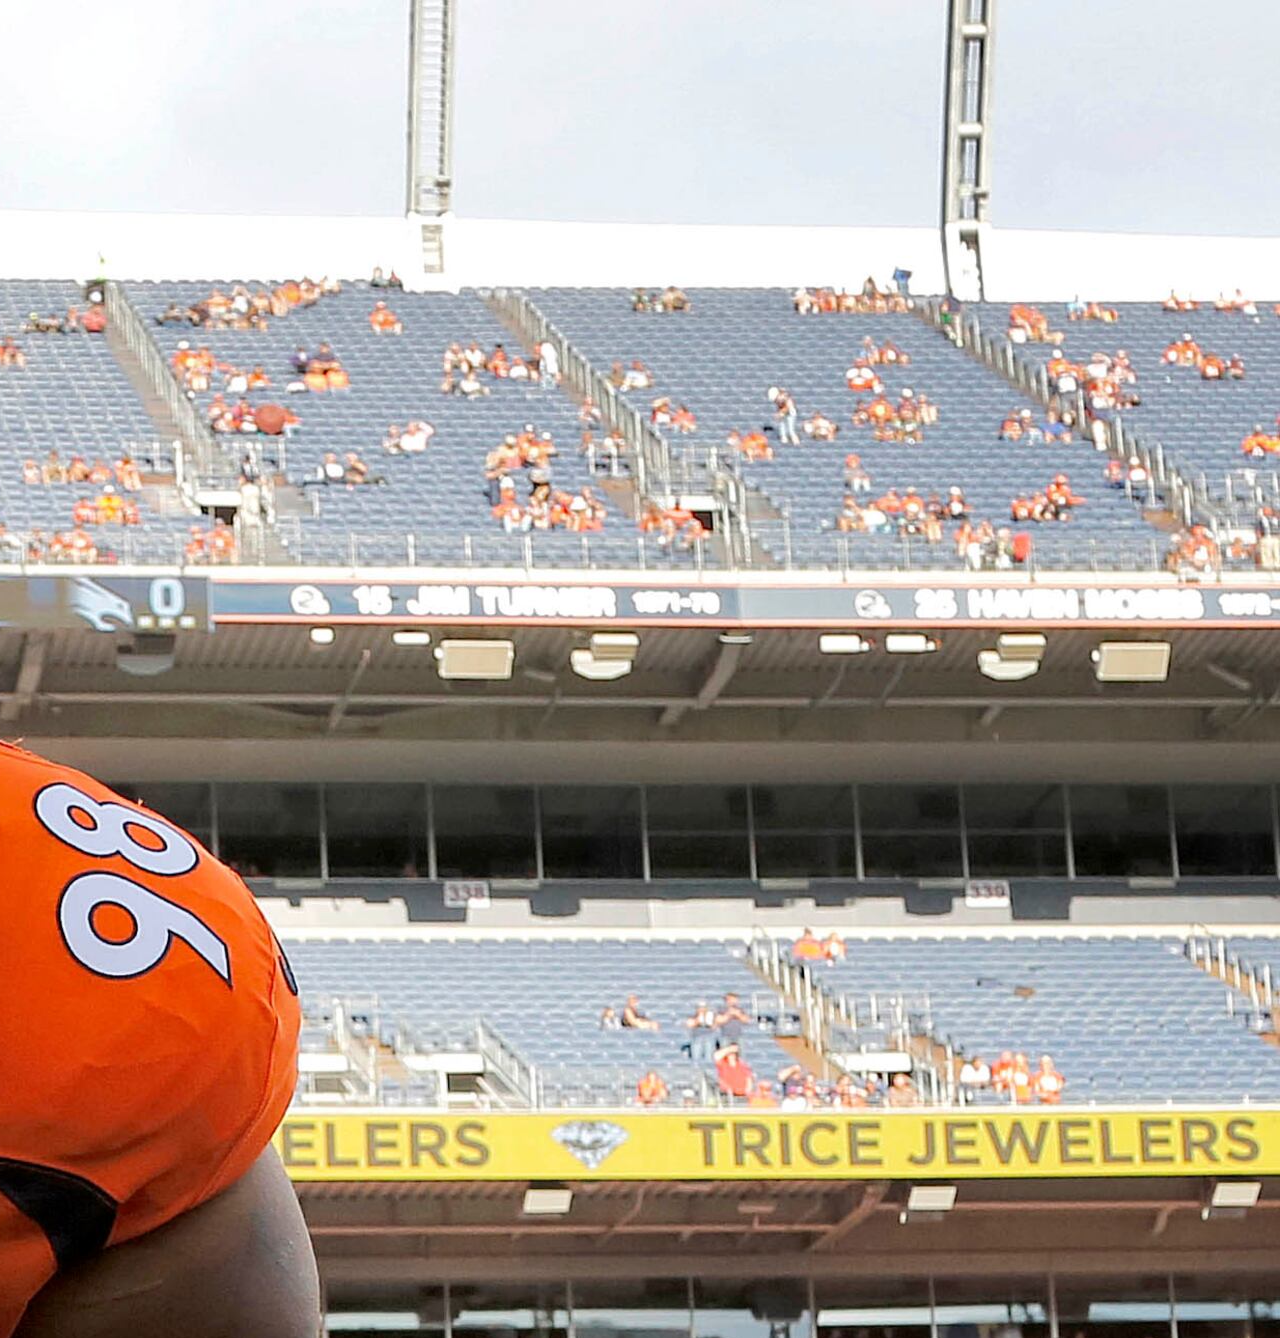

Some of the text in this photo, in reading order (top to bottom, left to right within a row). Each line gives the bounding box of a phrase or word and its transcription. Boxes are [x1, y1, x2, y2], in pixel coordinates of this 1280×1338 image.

[149, 578, 186, 617] 0
[34, 782, 233, 990] 98
[283, 1120, 491, 1168] ELERS
[689, 1118, 1261, 1167] TRICE JEWELERS
